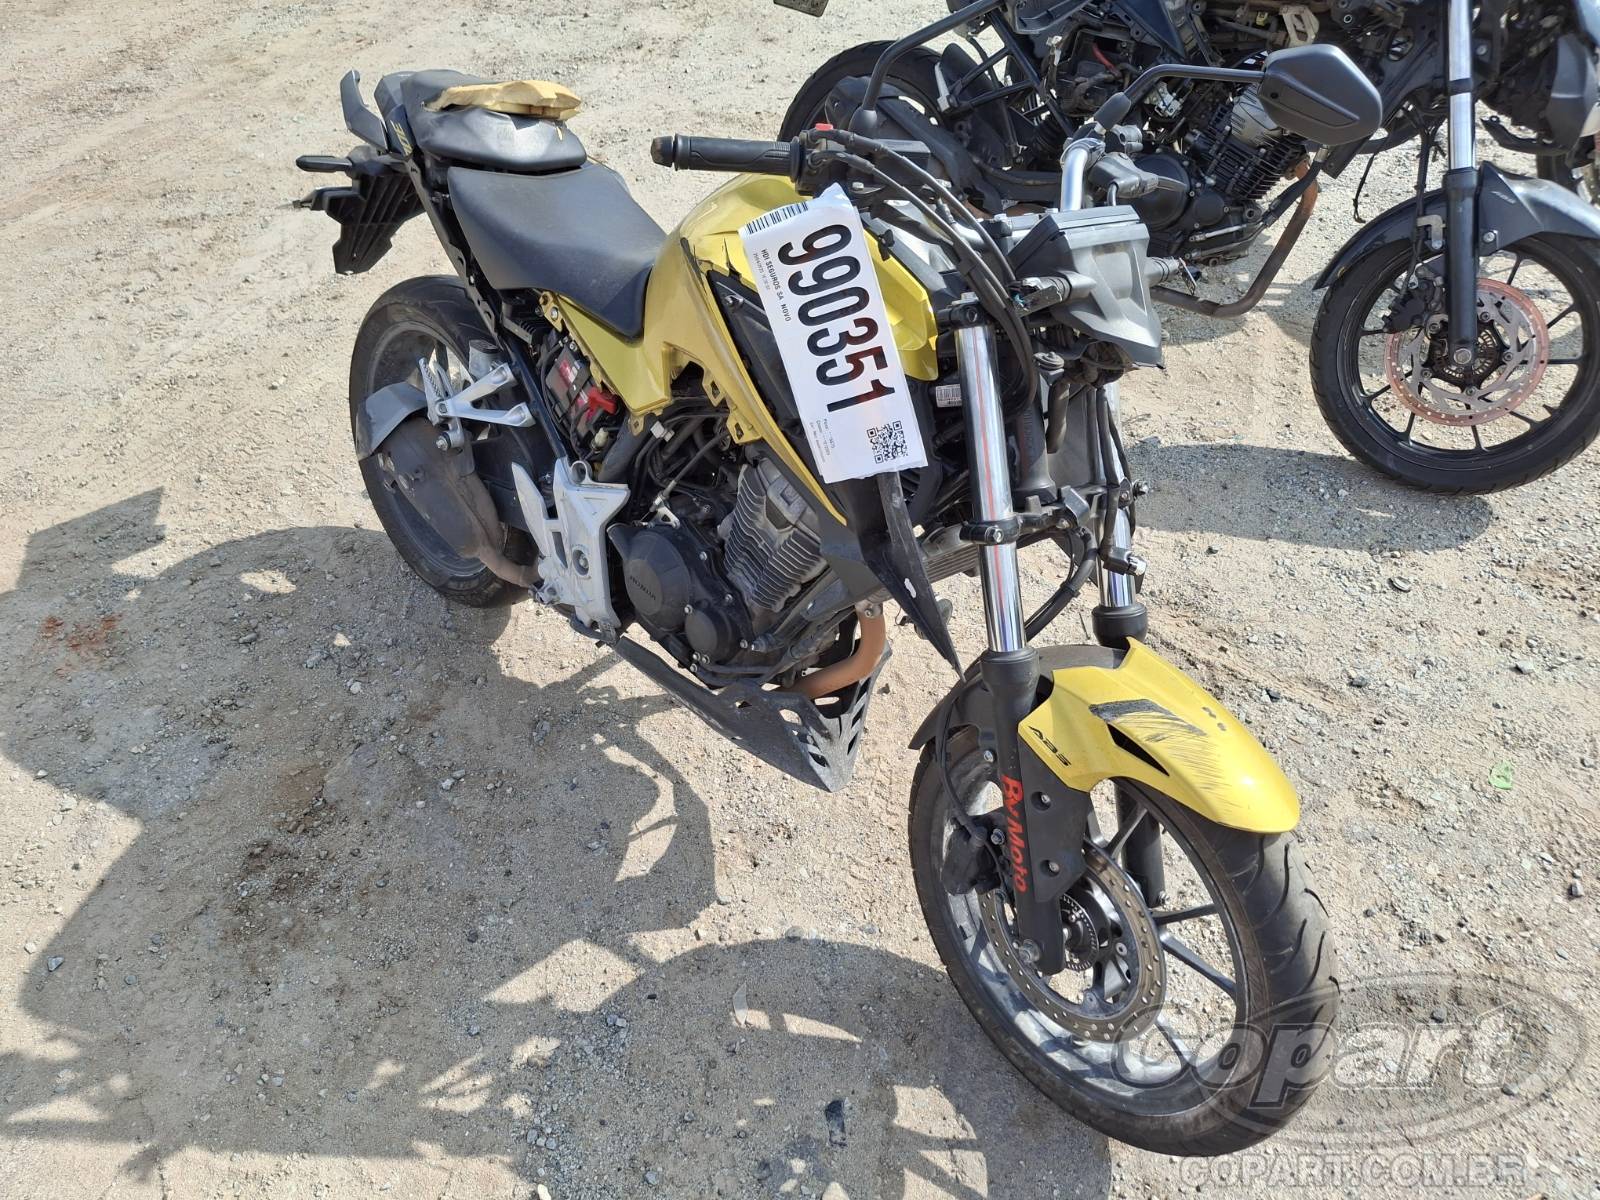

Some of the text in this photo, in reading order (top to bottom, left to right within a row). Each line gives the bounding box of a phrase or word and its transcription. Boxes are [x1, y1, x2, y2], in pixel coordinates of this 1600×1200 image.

[761, 248, 769, 260] HDI
[765, 260, 781, 289] SEGUROS
[776, 291, 785, 300] SA
[781, 303, 791, 321] NOVO
[778, 224, 895, 412] 990351
[1028, 725, 1072, 767] ABS
